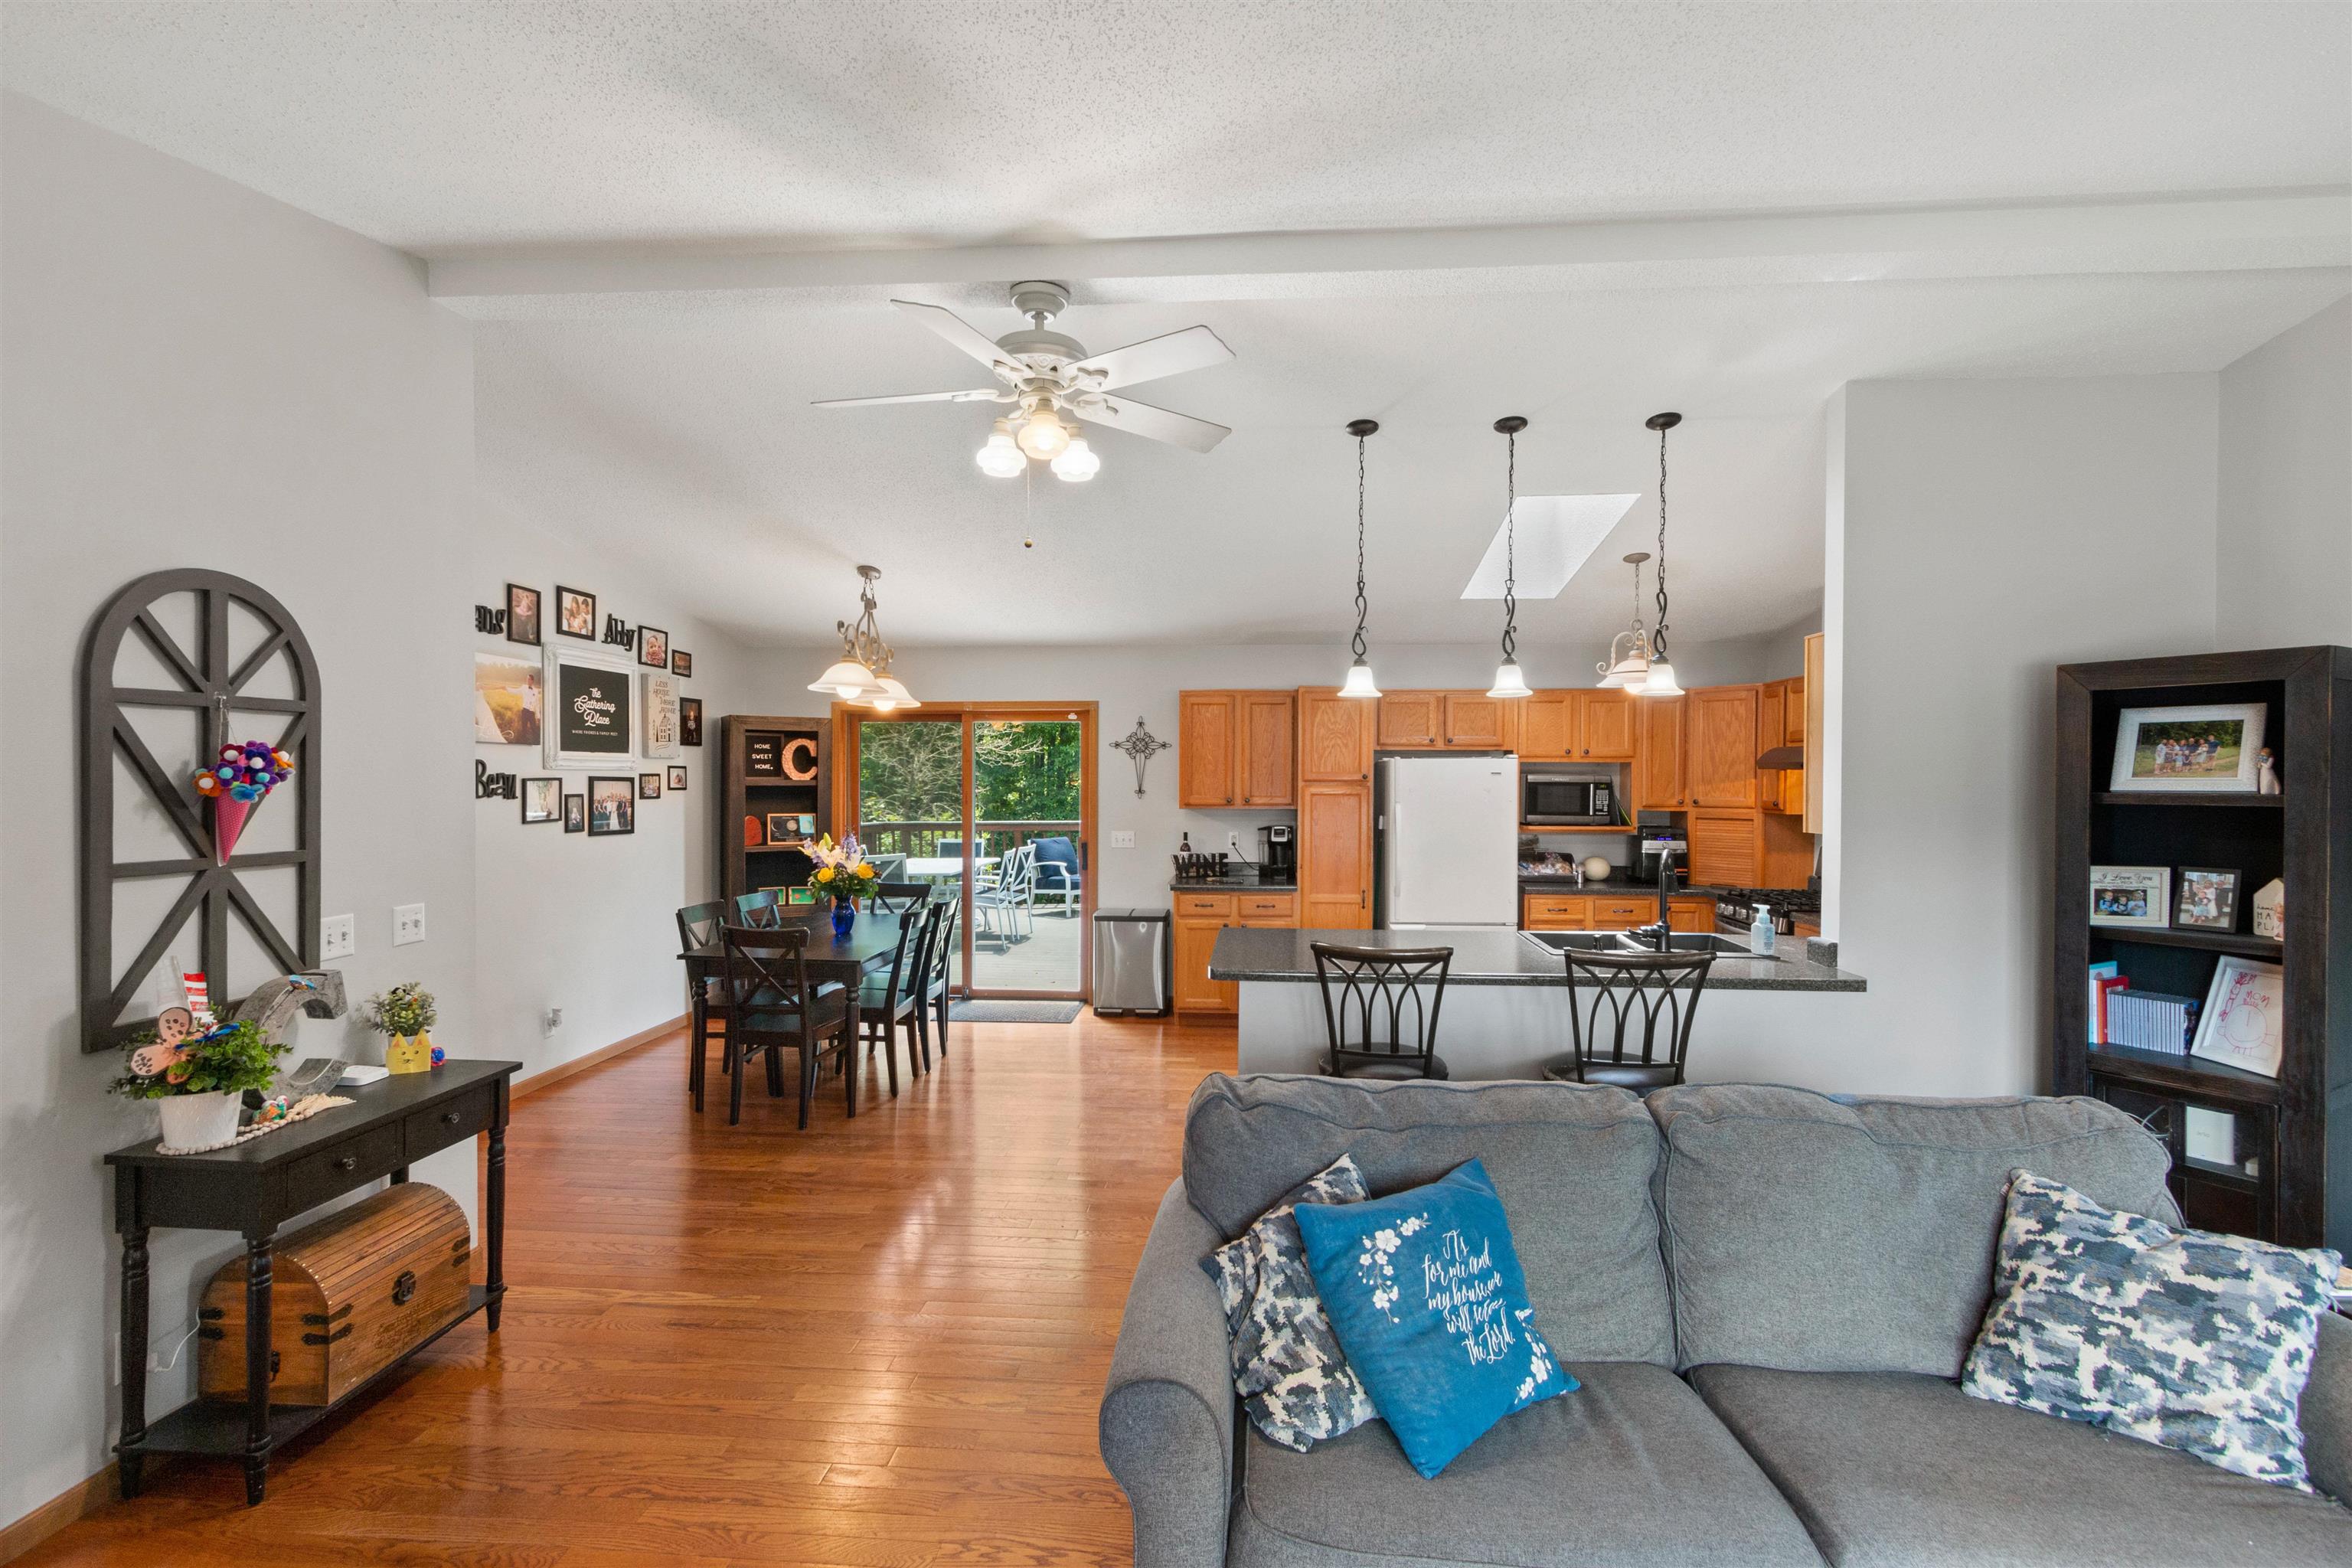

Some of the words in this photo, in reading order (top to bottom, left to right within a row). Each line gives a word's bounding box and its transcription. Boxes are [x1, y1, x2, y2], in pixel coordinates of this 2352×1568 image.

[601, 613, 636, 652] Abby
[573, 695, 616, 714] Gathering
[583, 710, 610, 727] Place
[782, 738, 818, 781] C
[475, 759, 519, 800] Beau
[1171, 852, 1229, 879] WINE
[1421, 1253, 1449, 1299] for
[1449, 1262, 1468, 1279] me
[1469, 1236, 1492, 1275] and
[1428, 1291, 1454, 1321] my
[1446, 1303, 1474, 1334] will
[1461, 1331, 1487, 1366] the
